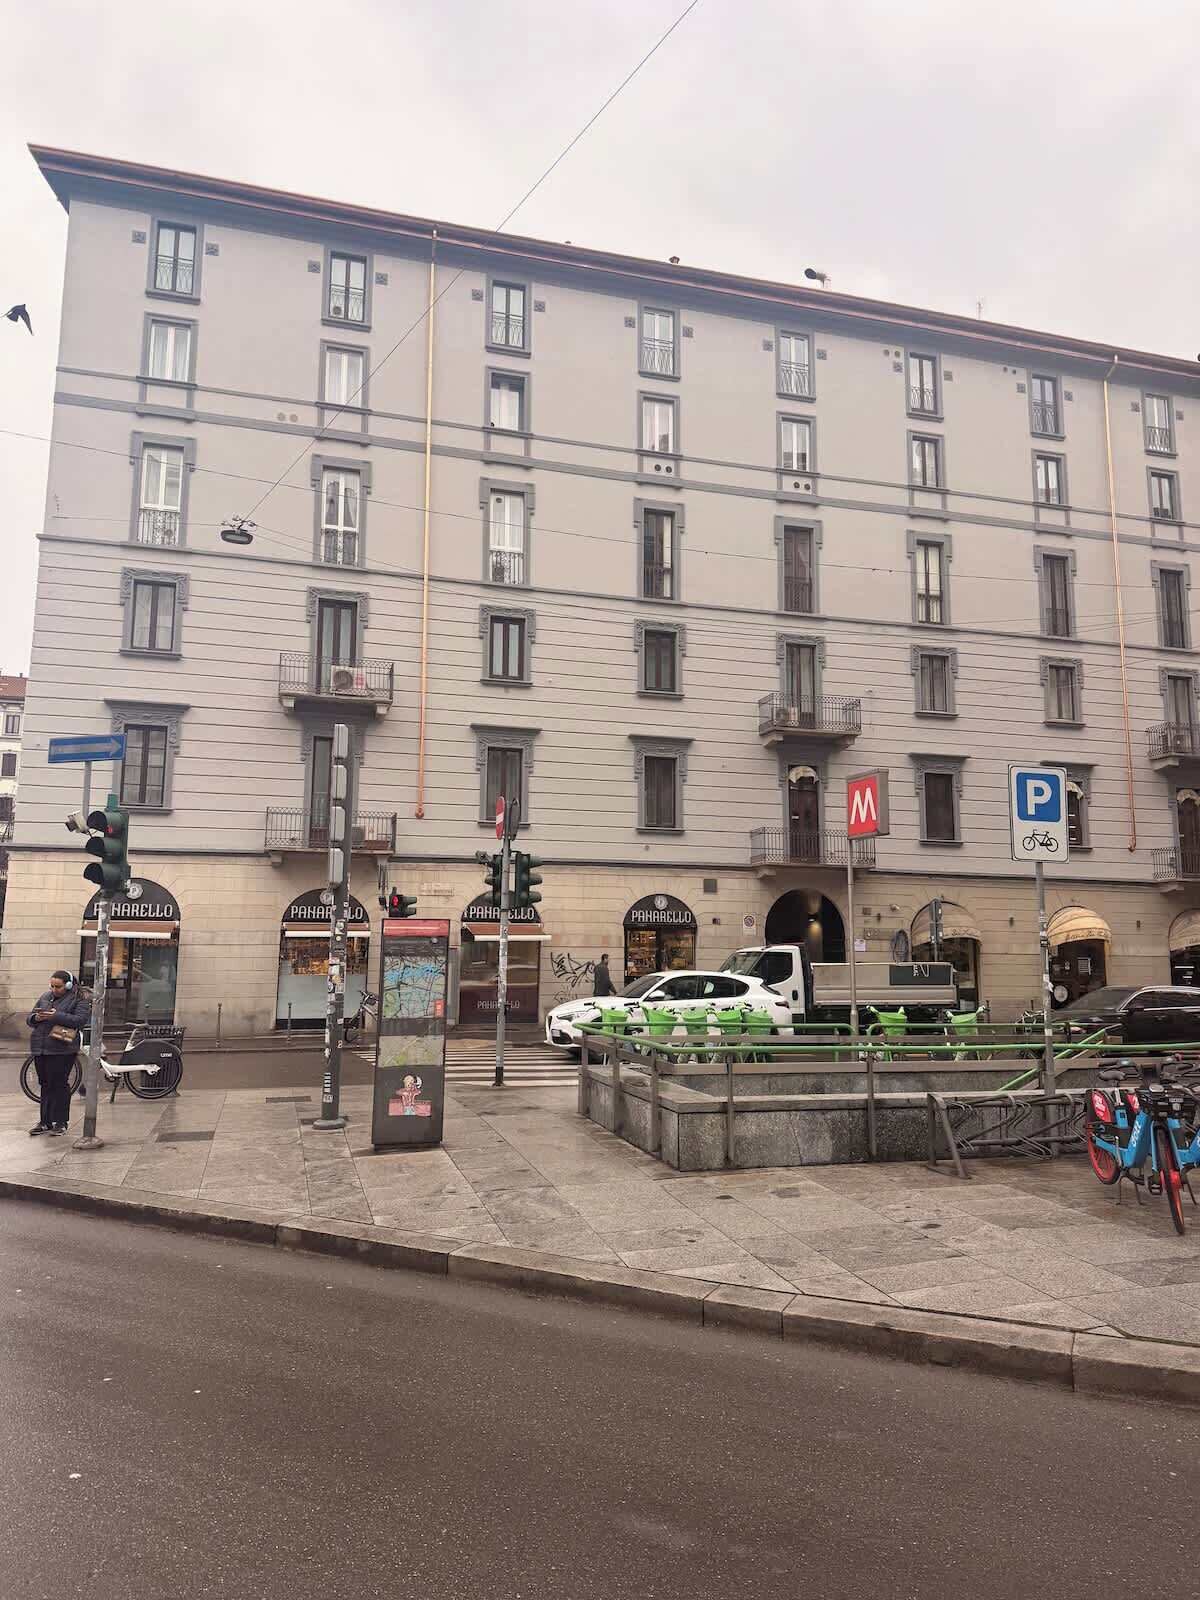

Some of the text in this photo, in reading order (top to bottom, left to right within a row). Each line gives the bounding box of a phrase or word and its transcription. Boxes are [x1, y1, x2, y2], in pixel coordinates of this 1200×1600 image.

[1026, 779, 1052, 816] P
[849, 787, 877, 825] M
[93, 903, 173, 918] PNARELLO
[290, 905, 364, 920] PANARLO
[469, 905, 535, 920] PANAELLO
[631, 910, 692, 923] PANARELLO
